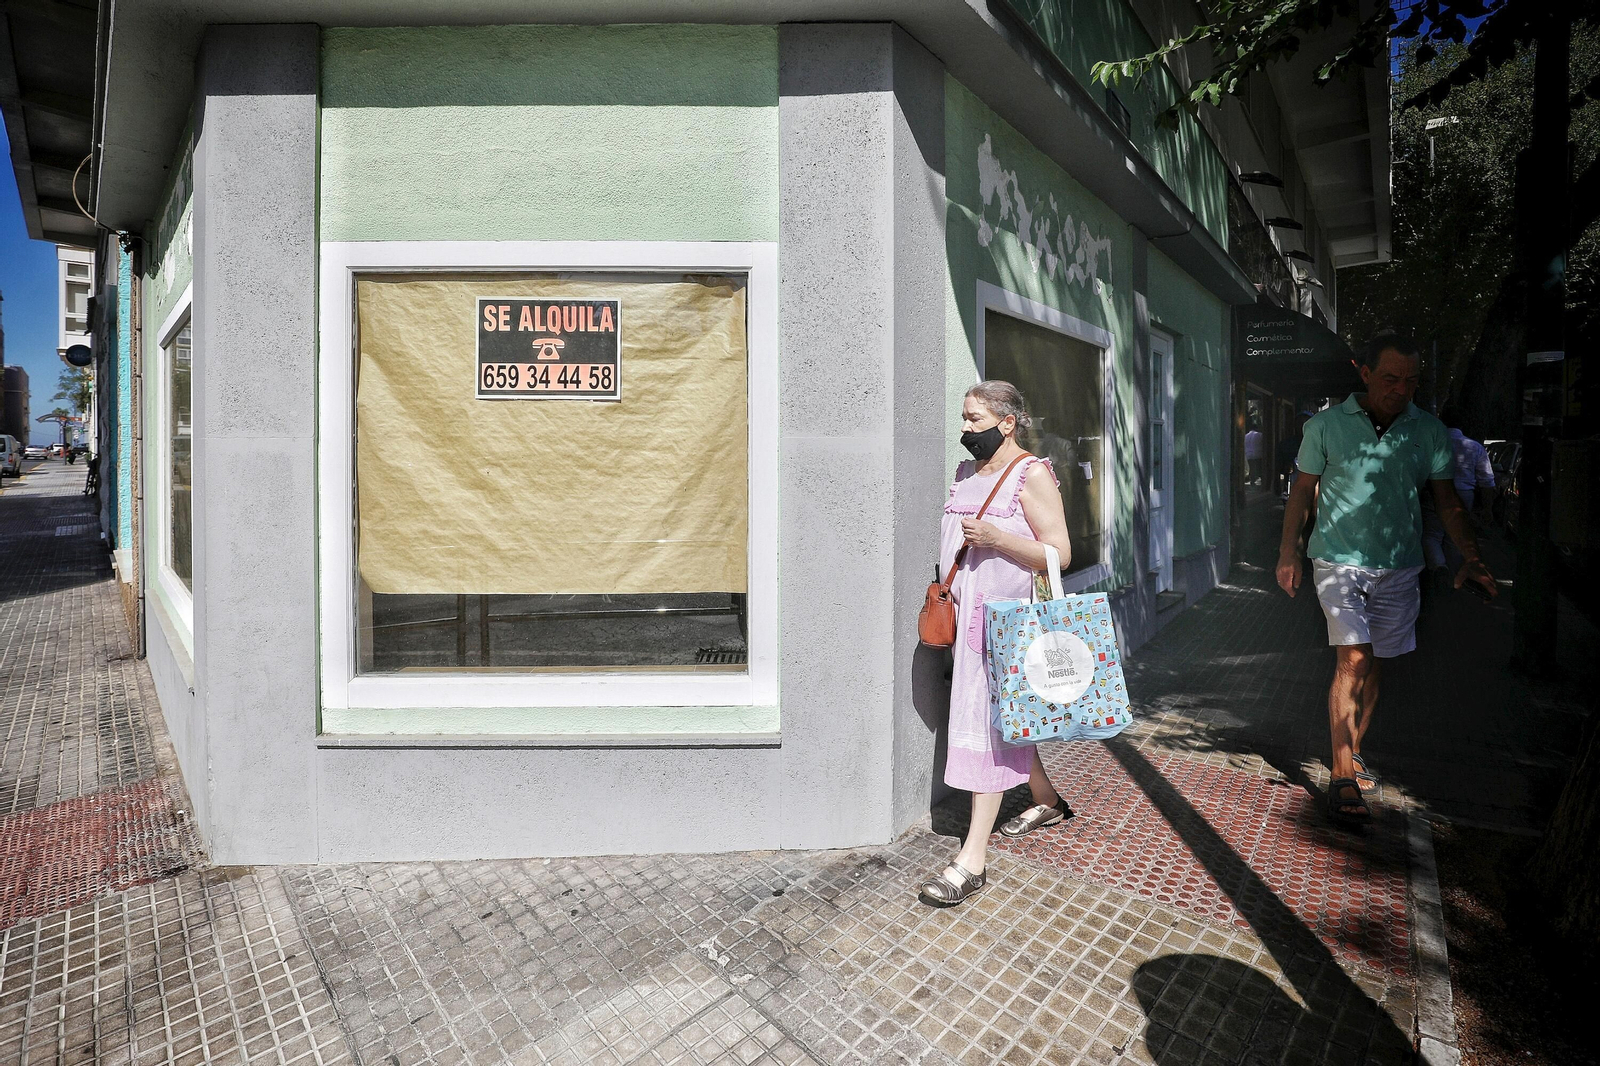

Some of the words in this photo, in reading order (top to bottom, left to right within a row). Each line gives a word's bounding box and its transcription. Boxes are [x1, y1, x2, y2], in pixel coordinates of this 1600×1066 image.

[483, 304, 511, 332] SE
[518, 304, 615, 336] ALQUILA
[1246, 333, 1293, 343] Cosmética
[1246, 347, 1314, 357] Complementos
[483, 364, 519, 389] 659
[526, 364, 551, 389] 34
[557, 365, 582, 389] 44
[588, 365, 612, 390] 58
